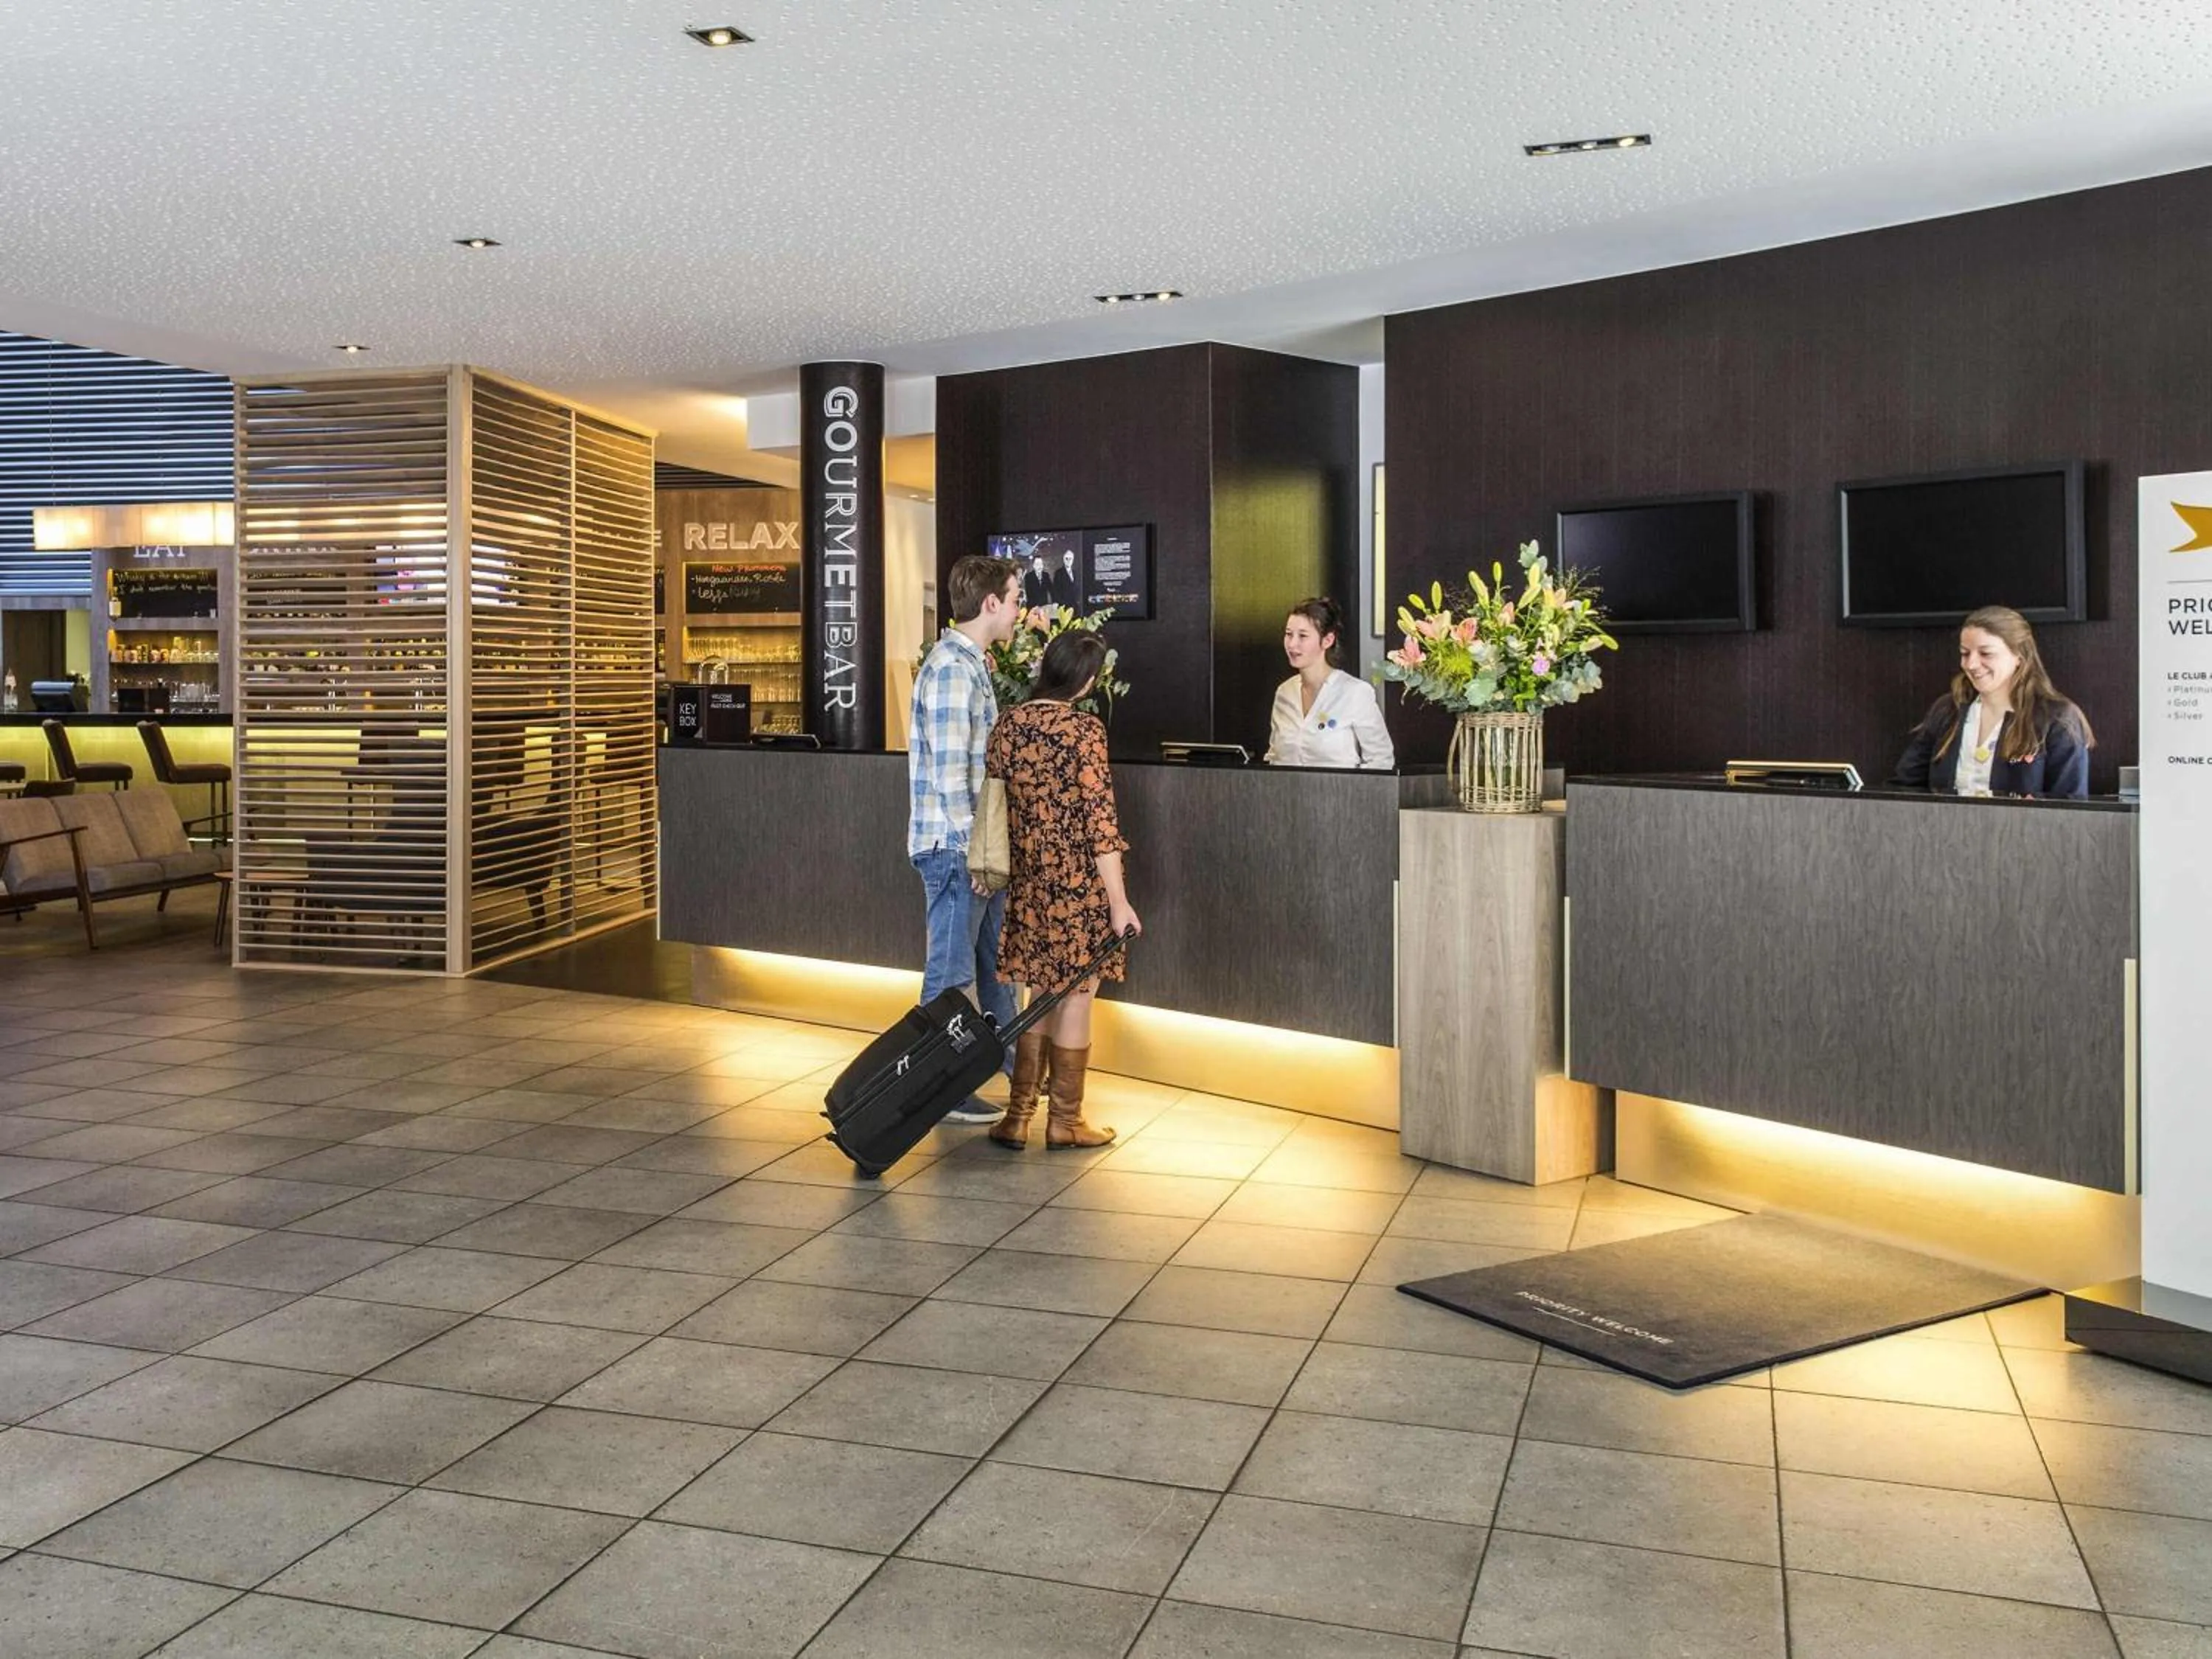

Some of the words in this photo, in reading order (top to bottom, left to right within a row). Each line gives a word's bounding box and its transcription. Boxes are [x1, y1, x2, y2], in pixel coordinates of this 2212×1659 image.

[684, 522, 800, 550] RELAX
[2168, 619, 2212, 635] WEL
[2168, 672, 2179, 680] LE
[2181, 672, 2207, 680] CLUB
[2173, 698, 2198, 706] Gold
[679, 703, 697, 714] KEY
[679, 716, 697, 726] BOX
[2168, 756, 2205, 765] ONLINE
